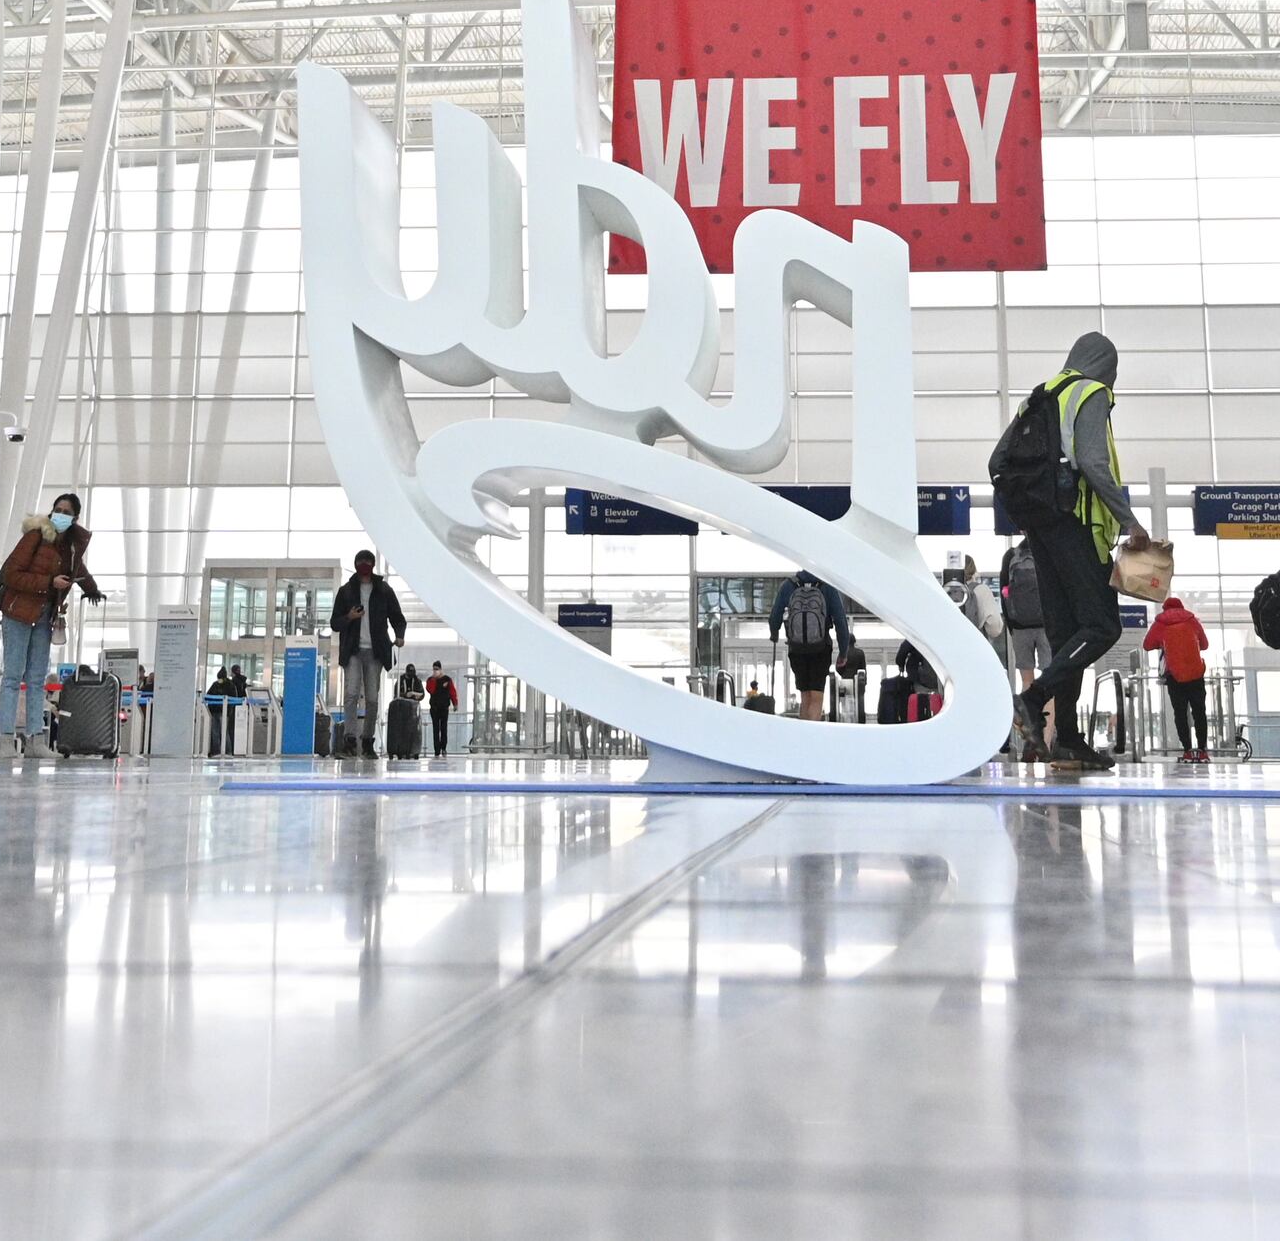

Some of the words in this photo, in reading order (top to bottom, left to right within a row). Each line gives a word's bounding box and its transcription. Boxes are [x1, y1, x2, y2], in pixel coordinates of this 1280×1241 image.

[632, 77, 801, 208] WE
[833, 72, 1017, 206] FLY
[1232, 503, 1262, 511] Garage
[605, 508, 639, 516] Elevator
[1228, 513, 1260, 523] Parking
